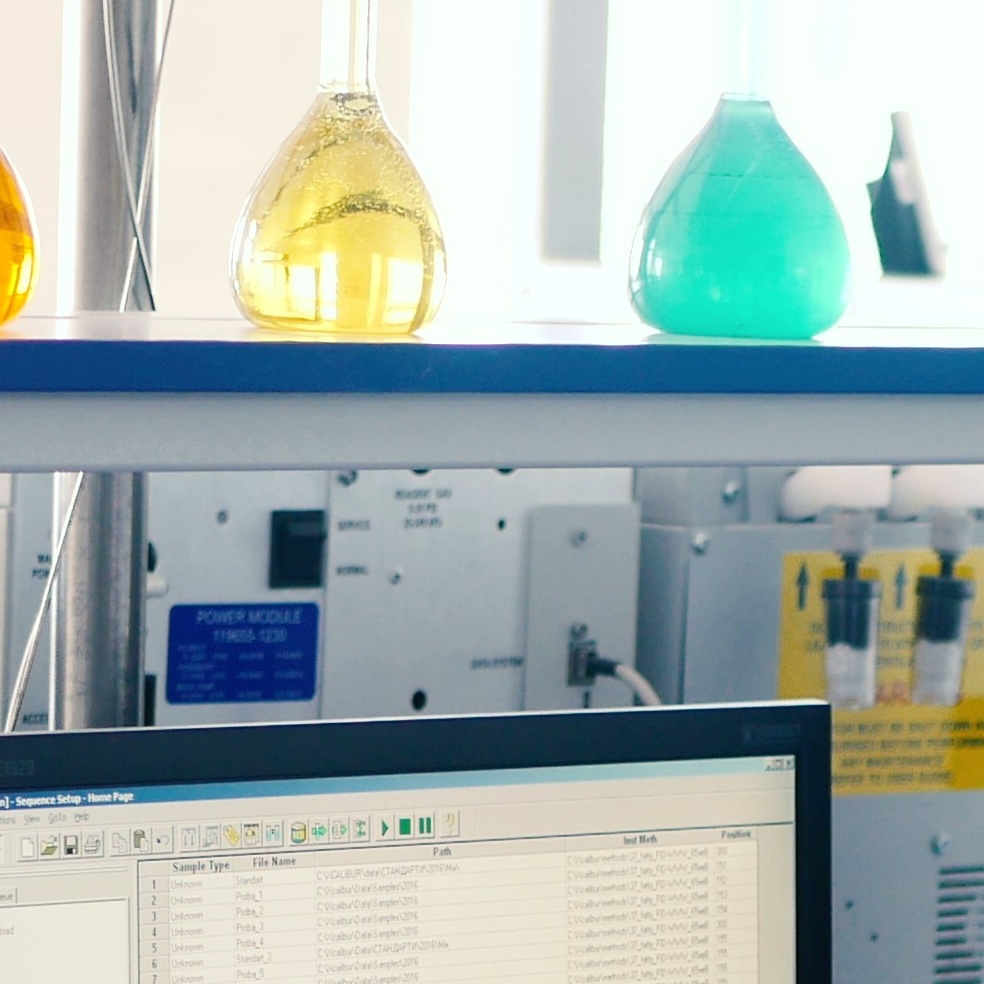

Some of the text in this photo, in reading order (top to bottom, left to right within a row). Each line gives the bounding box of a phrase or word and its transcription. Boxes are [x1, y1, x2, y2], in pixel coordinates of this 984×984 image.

[197, 608, 301, 625] POWER MODULE
[15, 796, 56, 807] Sequence
[57, 795, 81, 806] Setup
[88, 793, 112, 803] Home
[113, 792, 134, 803] Page
[74, 811, 89, 822] Help
[721, 830, 752, 839] Position
[433, 847, 452, 857] Path
[253, 856, 296, 867] File Name
[173, 860, 230, 874] Sample Type
[152, 879, 157, 889] 1
[171, 879, 203, 890] Unknown
[152, 895, 157, 905] 2
[171, 895, 203, 906] Unknown
[152, 911, 157, 921] 3
[171, 911, 203, 922] Unknown
[172, 927, 203, 937] Unknown
[152, 943, 157, 953] 5
[172, 943, 203, 953] Unknown
[152, 959, 158, 969] 6
[172, 959, 204, 969] Unknown
[172, 974, 204, 984] Unknown
